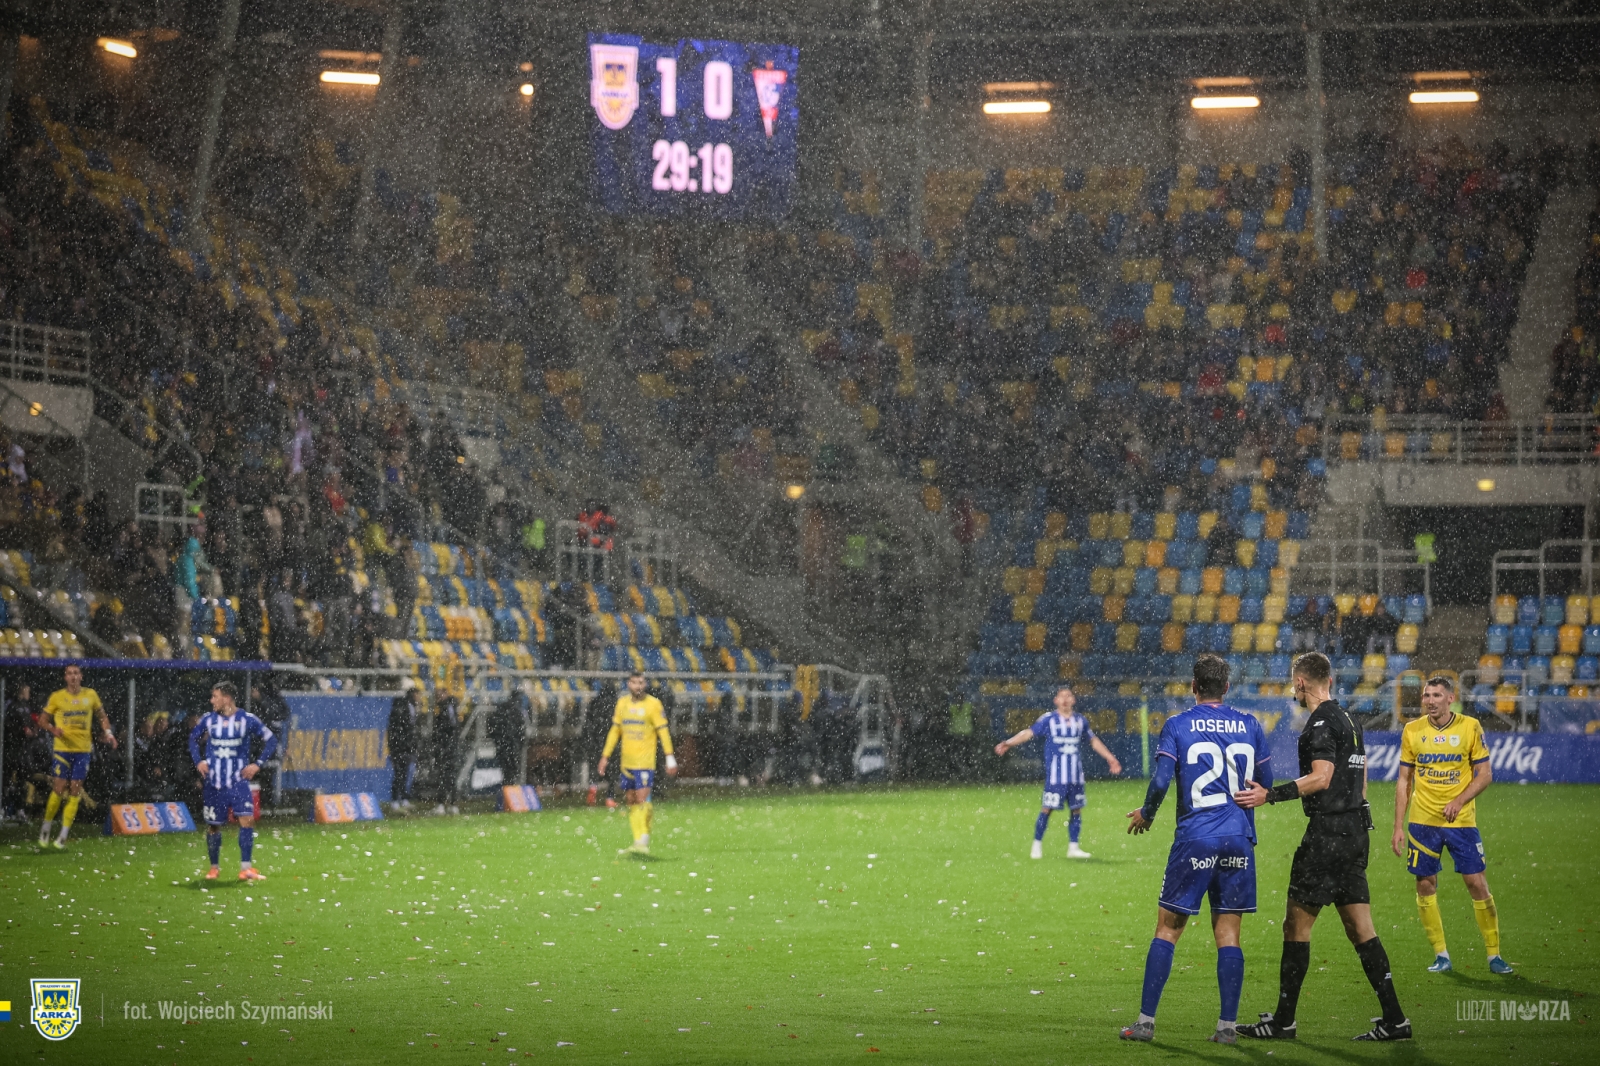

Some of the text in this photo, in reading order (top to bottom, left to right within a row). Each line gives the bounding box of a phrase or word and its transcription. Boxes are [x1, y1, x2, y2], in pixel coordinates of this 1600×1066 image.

[656, 57, 733, 120] 1 0
[652, 139, 733, 194] 29:19
[1190, 719, 1247, 733] JOSEMA
[1434, 734, 1446, 743] STS
[1417, 753, 1462, 764] GDYNIA
[1187, 741, 1255, 808] 20
[1428, 767, 1461, 780] Energa
[1189, 855, 1219, 870] BODY
